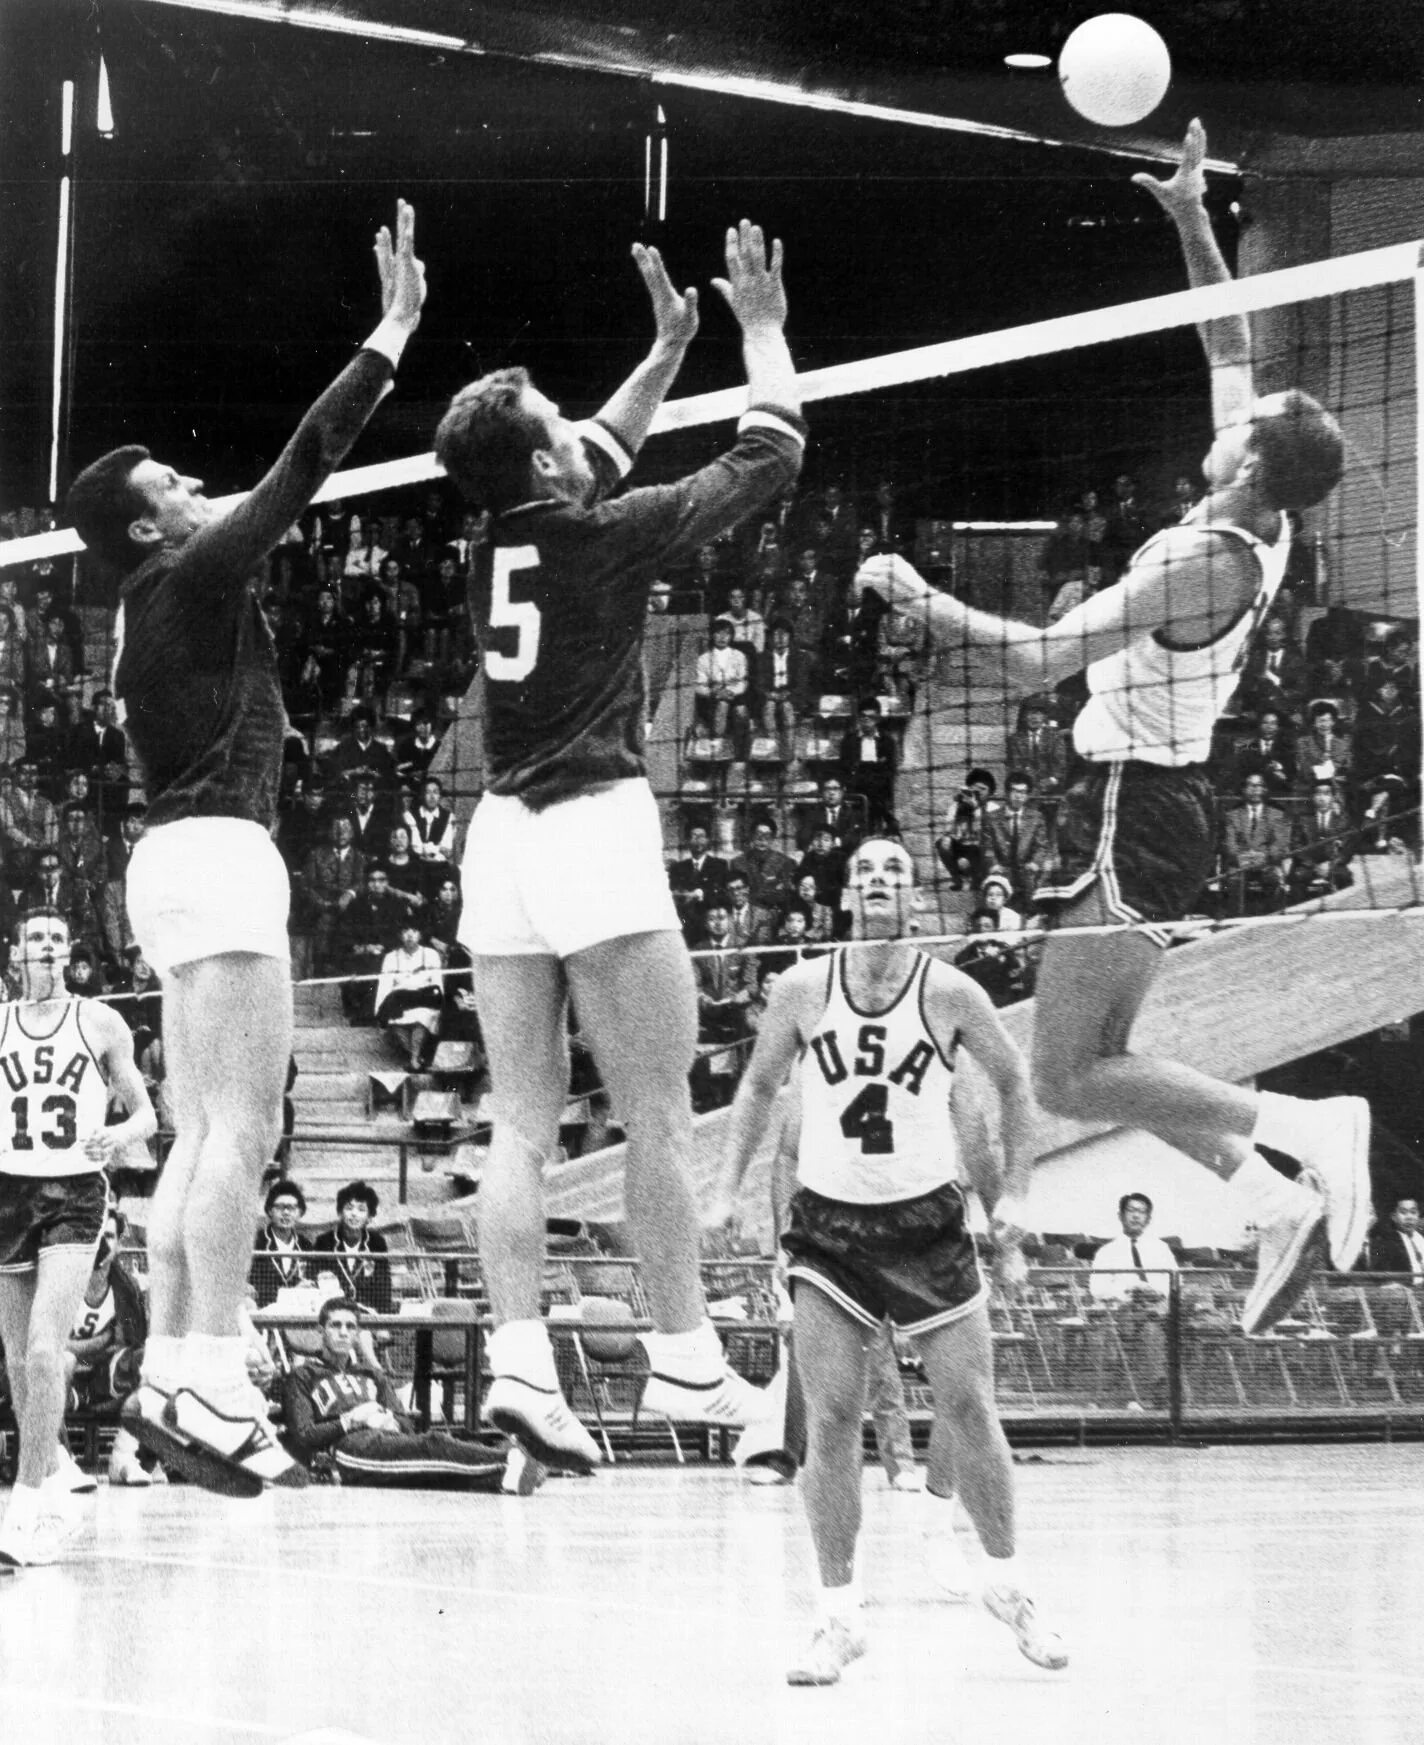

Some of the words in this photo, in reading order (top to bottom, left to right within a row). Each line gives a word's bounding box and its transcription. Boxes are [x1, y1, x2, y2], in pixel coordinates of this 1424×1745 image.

[485, 545, 541, 682] 5
[0, 1046, 89, 1094] USA
[811, 1025, 935, 1096] USA
[11, 1095, 77, 1151] 13
[840, 1083, 895, 1154] 4
